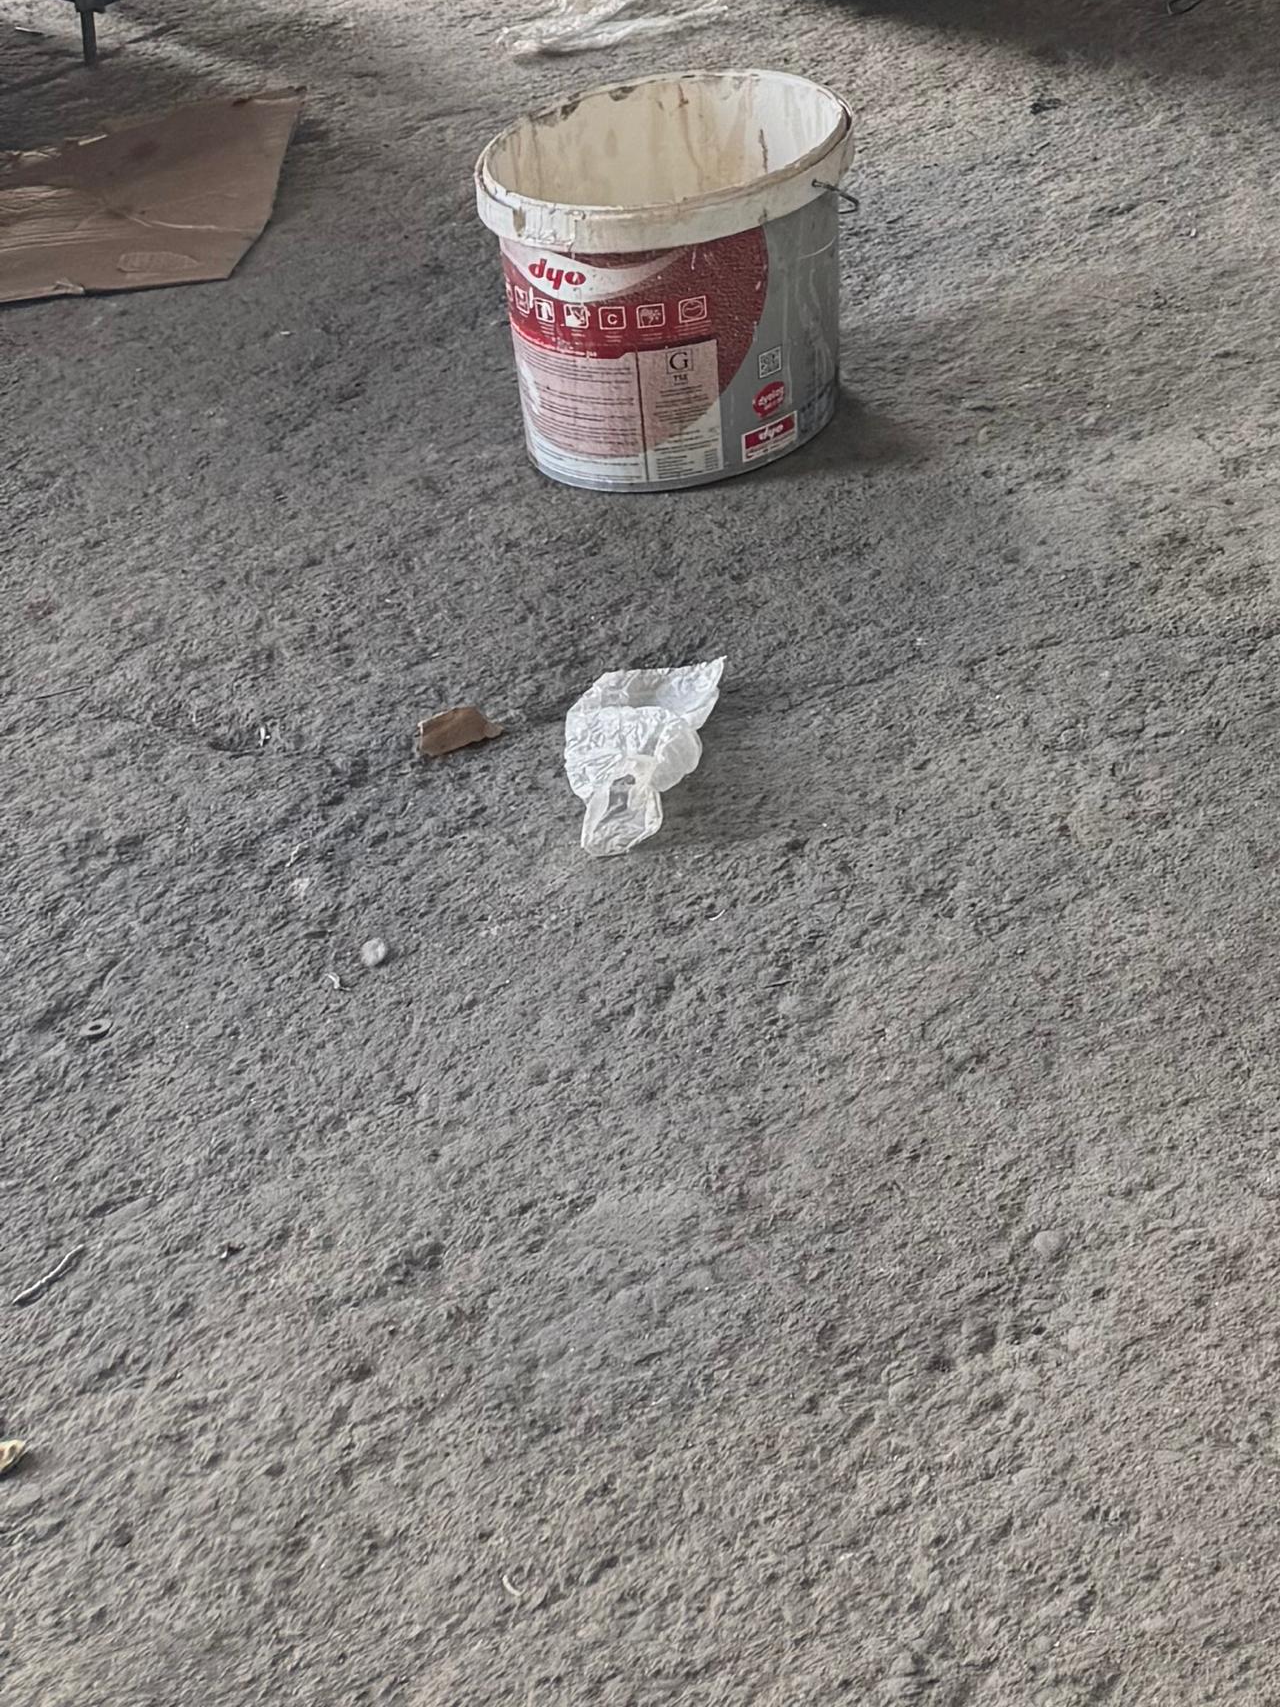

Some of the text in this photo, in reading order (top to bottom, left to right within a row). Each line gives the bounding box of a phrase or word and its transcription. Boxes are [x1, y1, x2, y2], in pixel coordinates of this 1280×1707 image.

[528, 259, 587, 290] dyo
[669, 351, 689, 371] G
[758, 421, 784, 442] dyo
